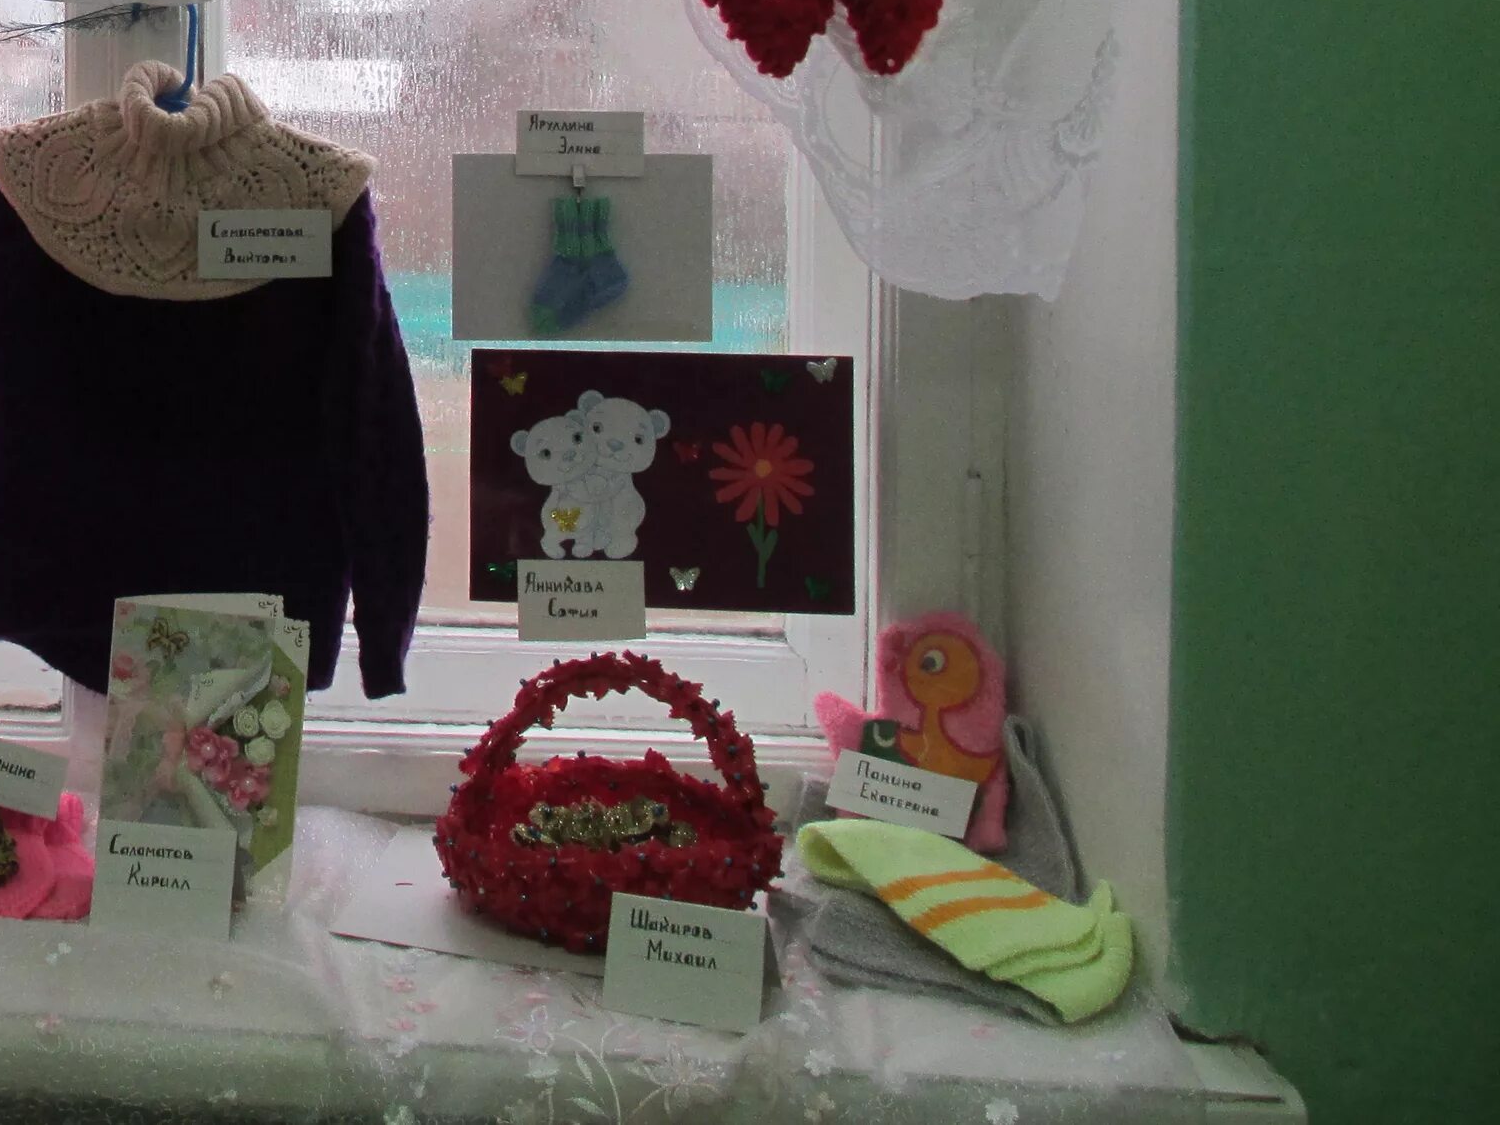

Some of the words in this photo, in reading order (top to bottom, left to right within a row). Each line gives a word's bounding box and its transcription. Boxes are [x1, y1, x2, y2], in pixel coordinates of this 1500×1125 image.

[528, 114, 595, 132] Яруллина
[224, 247, 298, 264] Виктория
[548, 597, 599, 619] София
[857, 759, 923, 792] Панина
[859, 781, 940, 817] Екатерина
[108, 833, 194, 860] Саламатов
[127, 861, 191, 890] Кирилл
[630, 907, 713, 940] Шакиров
[647, 938, 717, 970] Михаил
